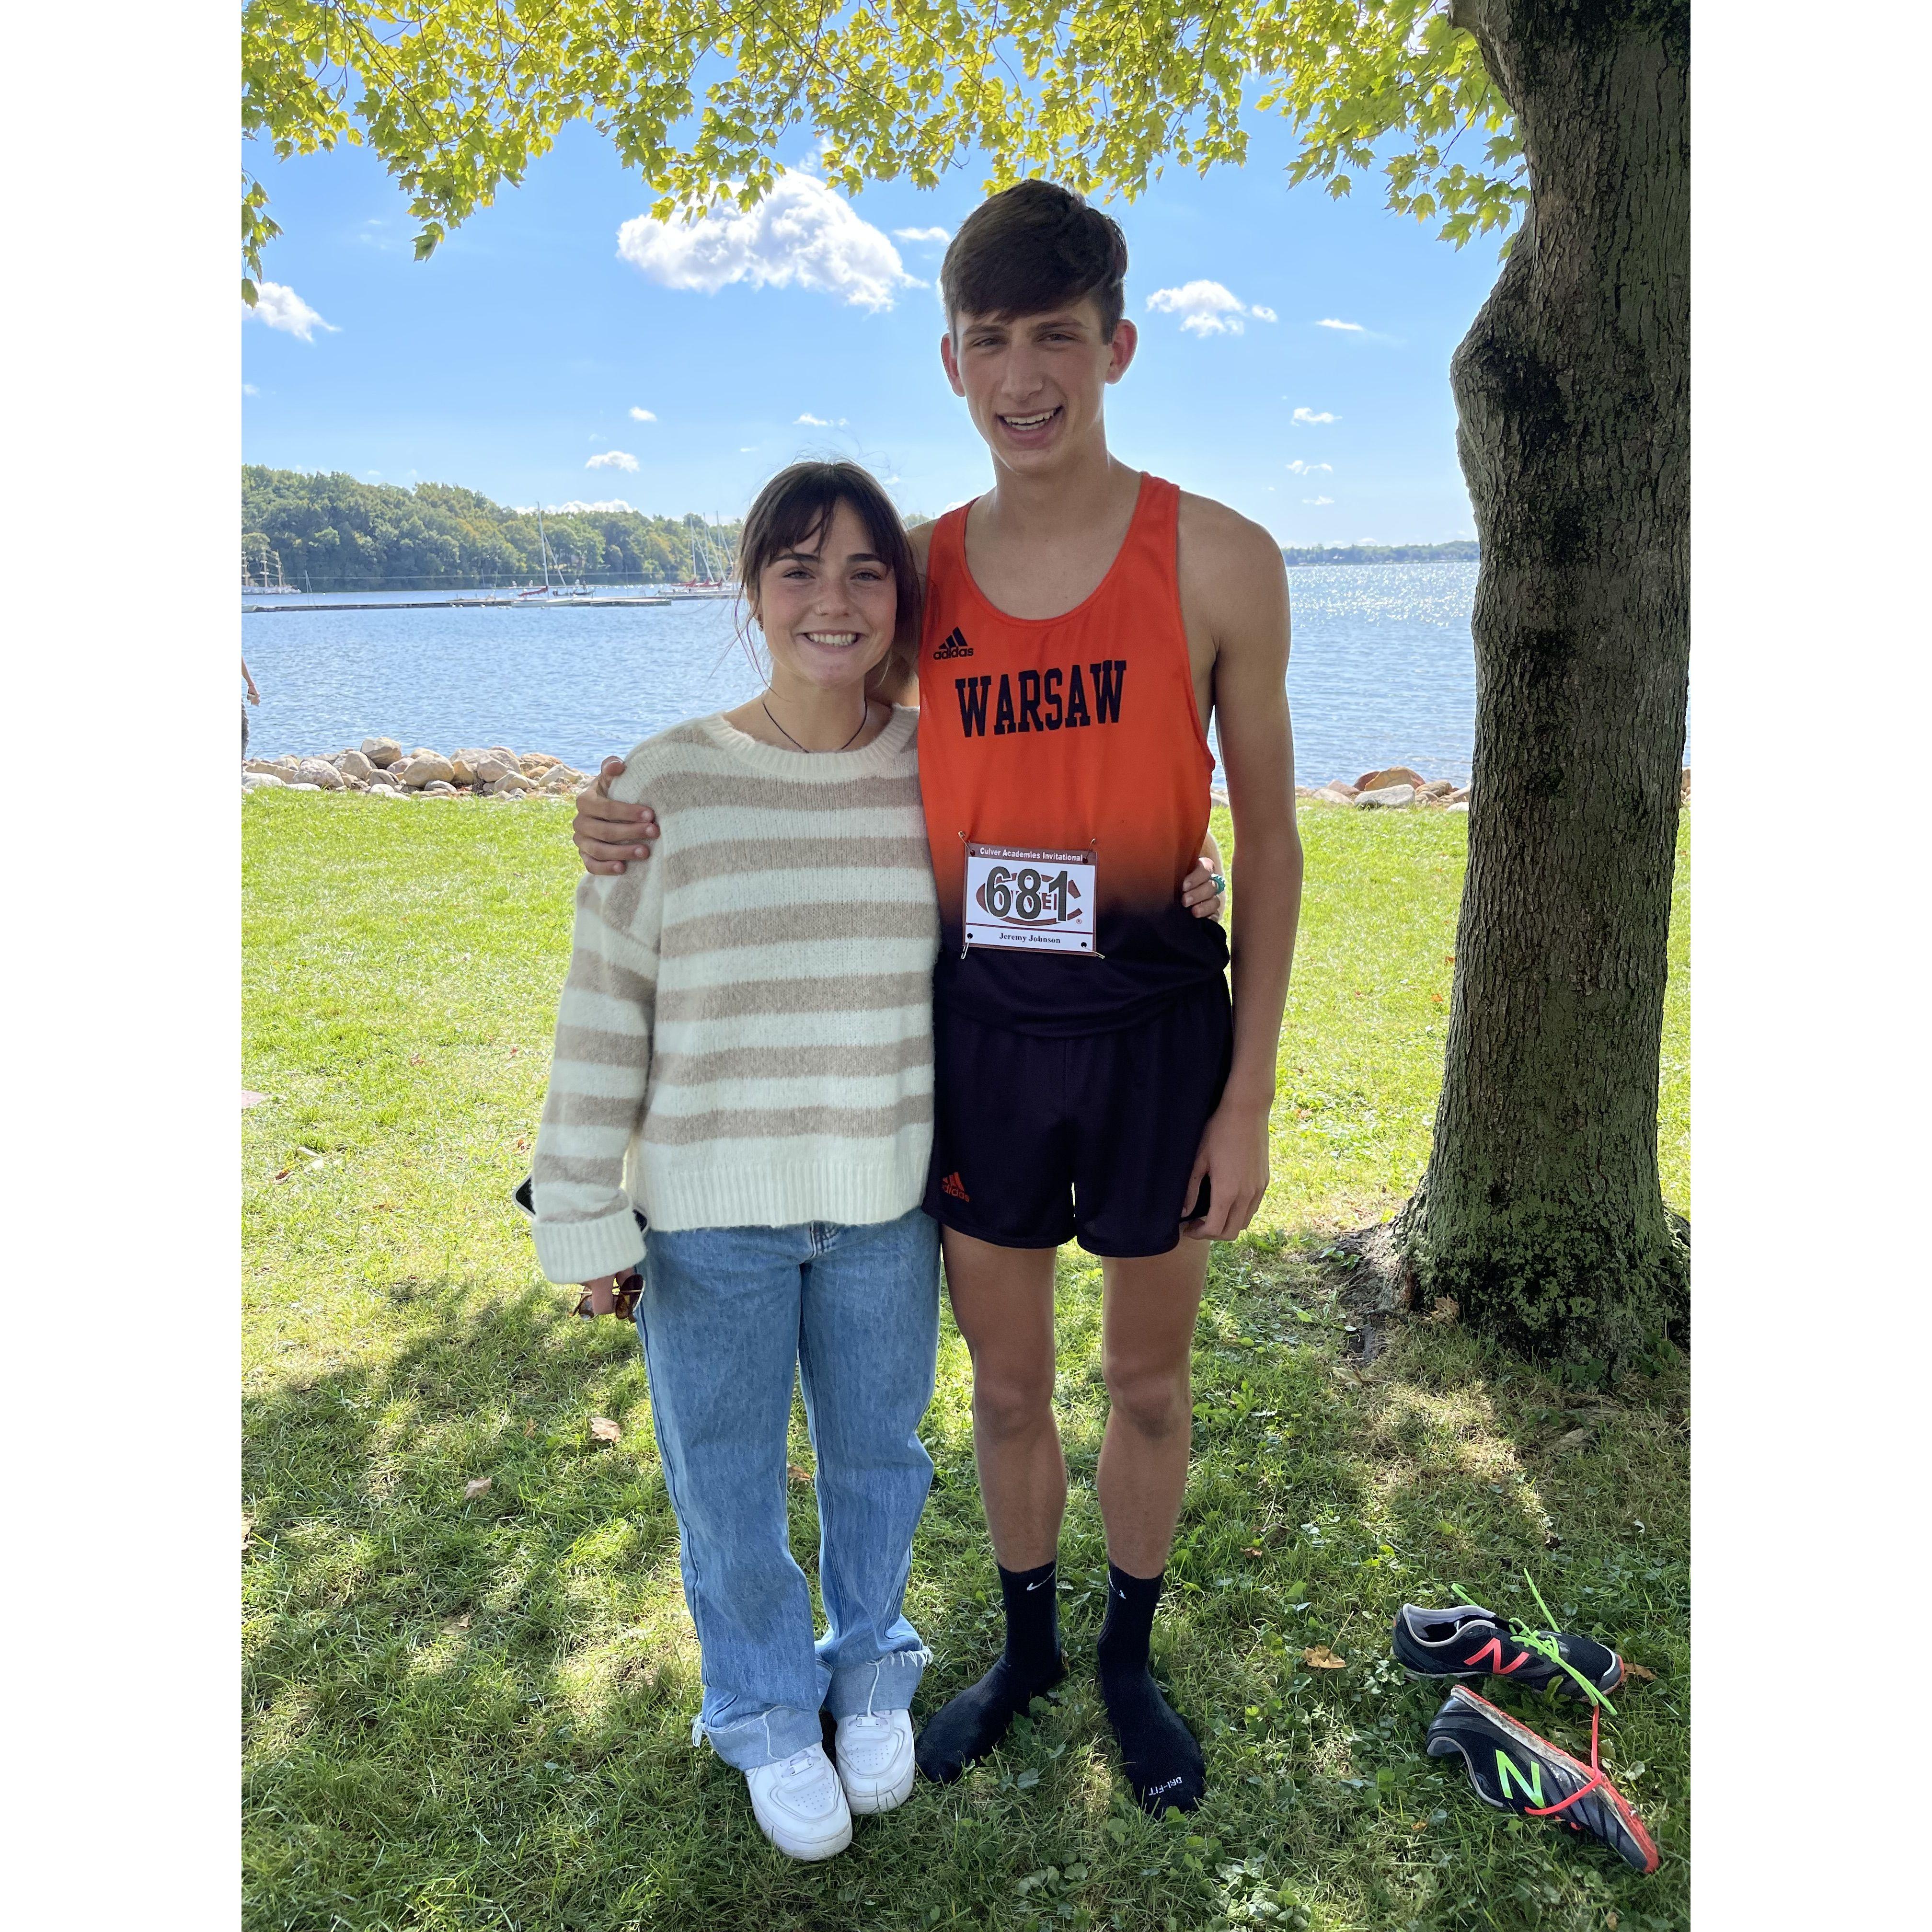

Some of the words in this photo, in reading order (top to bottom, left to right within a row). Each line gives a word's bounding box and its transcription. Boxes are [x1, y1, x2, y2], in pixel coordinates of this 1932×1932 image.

[933, 646, 974, 660] adidas
[955, 660, 1127, 738] WARSAW
[980, 847, 1001, 856] Culver
[1002, 849, 1040, 859] Academies
[1043, 851, 1082, 862] Invitational
[987, 866, 1068, 921] 681
[999, 932, 1027, 943] Jeremy
[1029, 935, 1060, 943] Johnson
[1149, 1777, 1183, 1796] DRI-FIT
[1495, 1749, 1545, 1808] N
